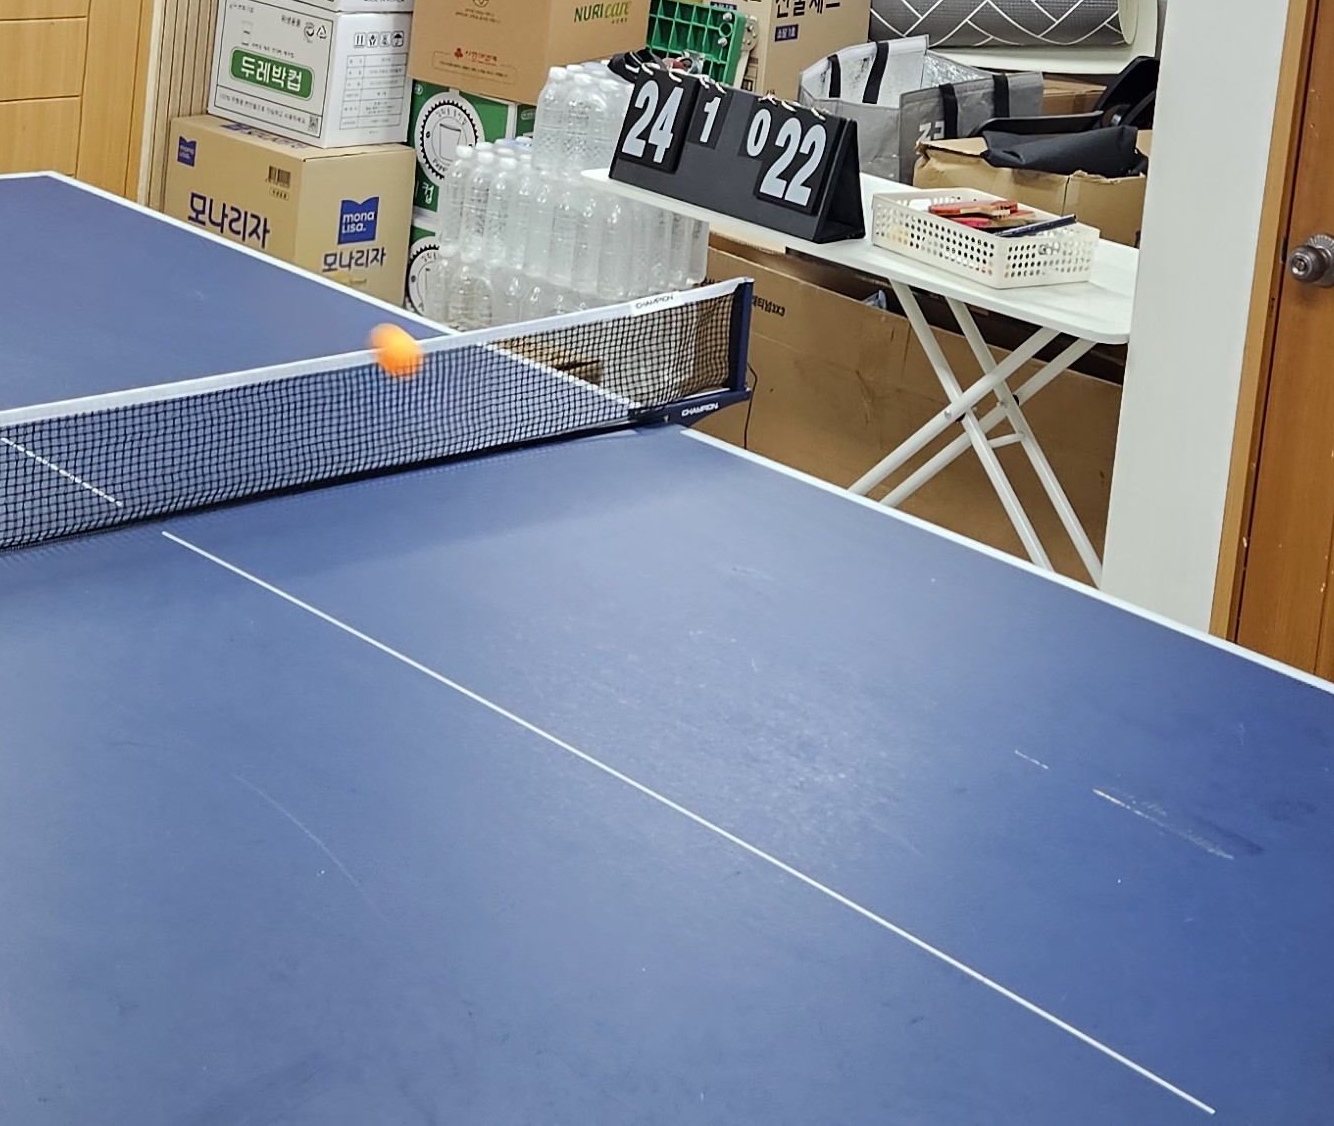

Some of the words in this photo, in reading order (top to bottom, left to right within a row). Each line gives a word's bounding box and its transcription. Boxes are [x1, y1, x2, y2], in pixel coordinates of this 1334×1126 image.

[240, 55, 303, 92] 두레박컵
[622, 79, 685, 164] 24
[700, 96, 722, 143] 1
[747, 108, 770, 157] 0
[759, 117, 827, 207] 22
[187, 191, 271, 249] 모나리자
[342, 210, 375, 223] mona
[322, 246, 387, 273] 모나리자
[635, 293, 674, 310] CHAMPION
[681, 402, 719, 417] CHAMPION
